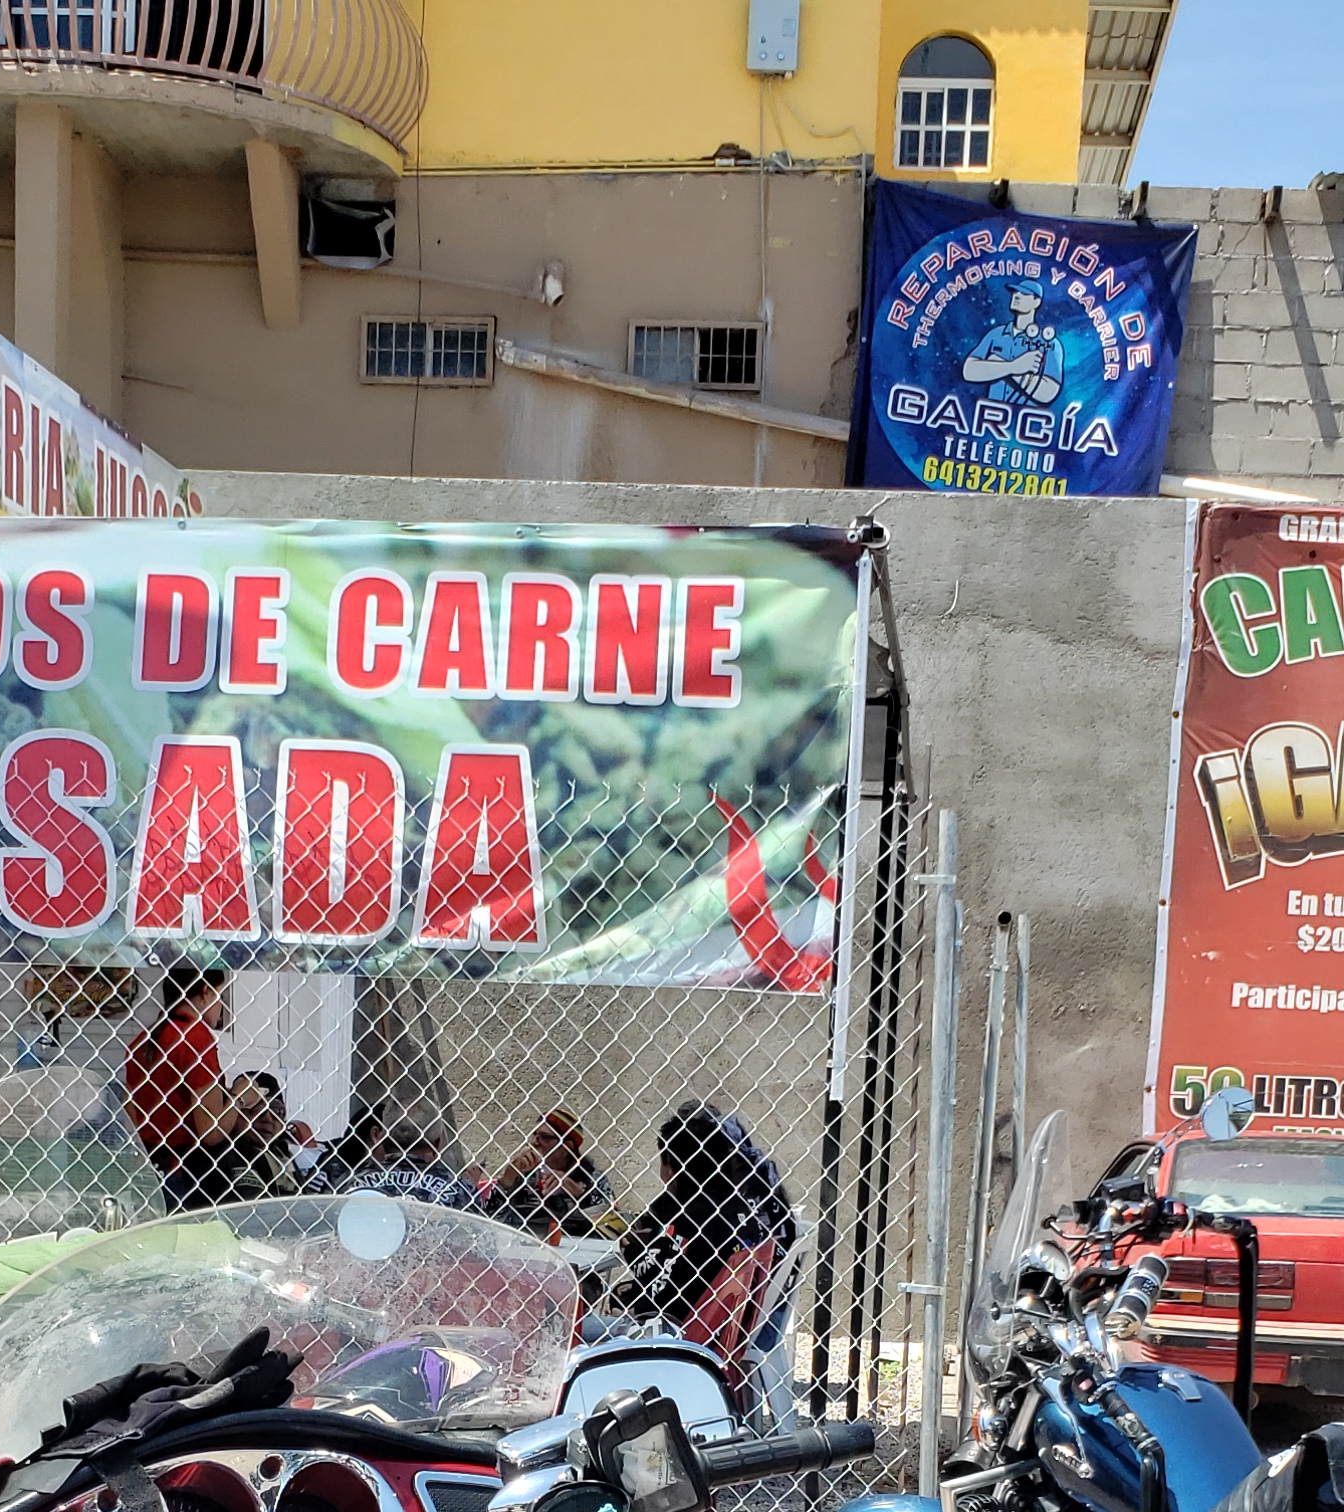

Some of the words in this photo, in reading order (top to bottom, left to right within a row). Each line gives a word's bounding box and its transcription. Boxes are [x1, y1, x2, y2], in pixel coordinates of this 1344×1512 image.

[887, 227, 1125, 331] REPARACIÓN
[1119, 312, 1152, 372] DE
[912, 260, 1042, 349] THERMOKING
[1050, 268, 1067, 286] Y
[887, 383, 1119, 457] GARCÍA
[943, 436, 1056, 474] TELÉFONO
[132, 566, 289, 695] DE
[326, 570, 746, 708] CARNE
[1287, 890, 1319, 917] En
